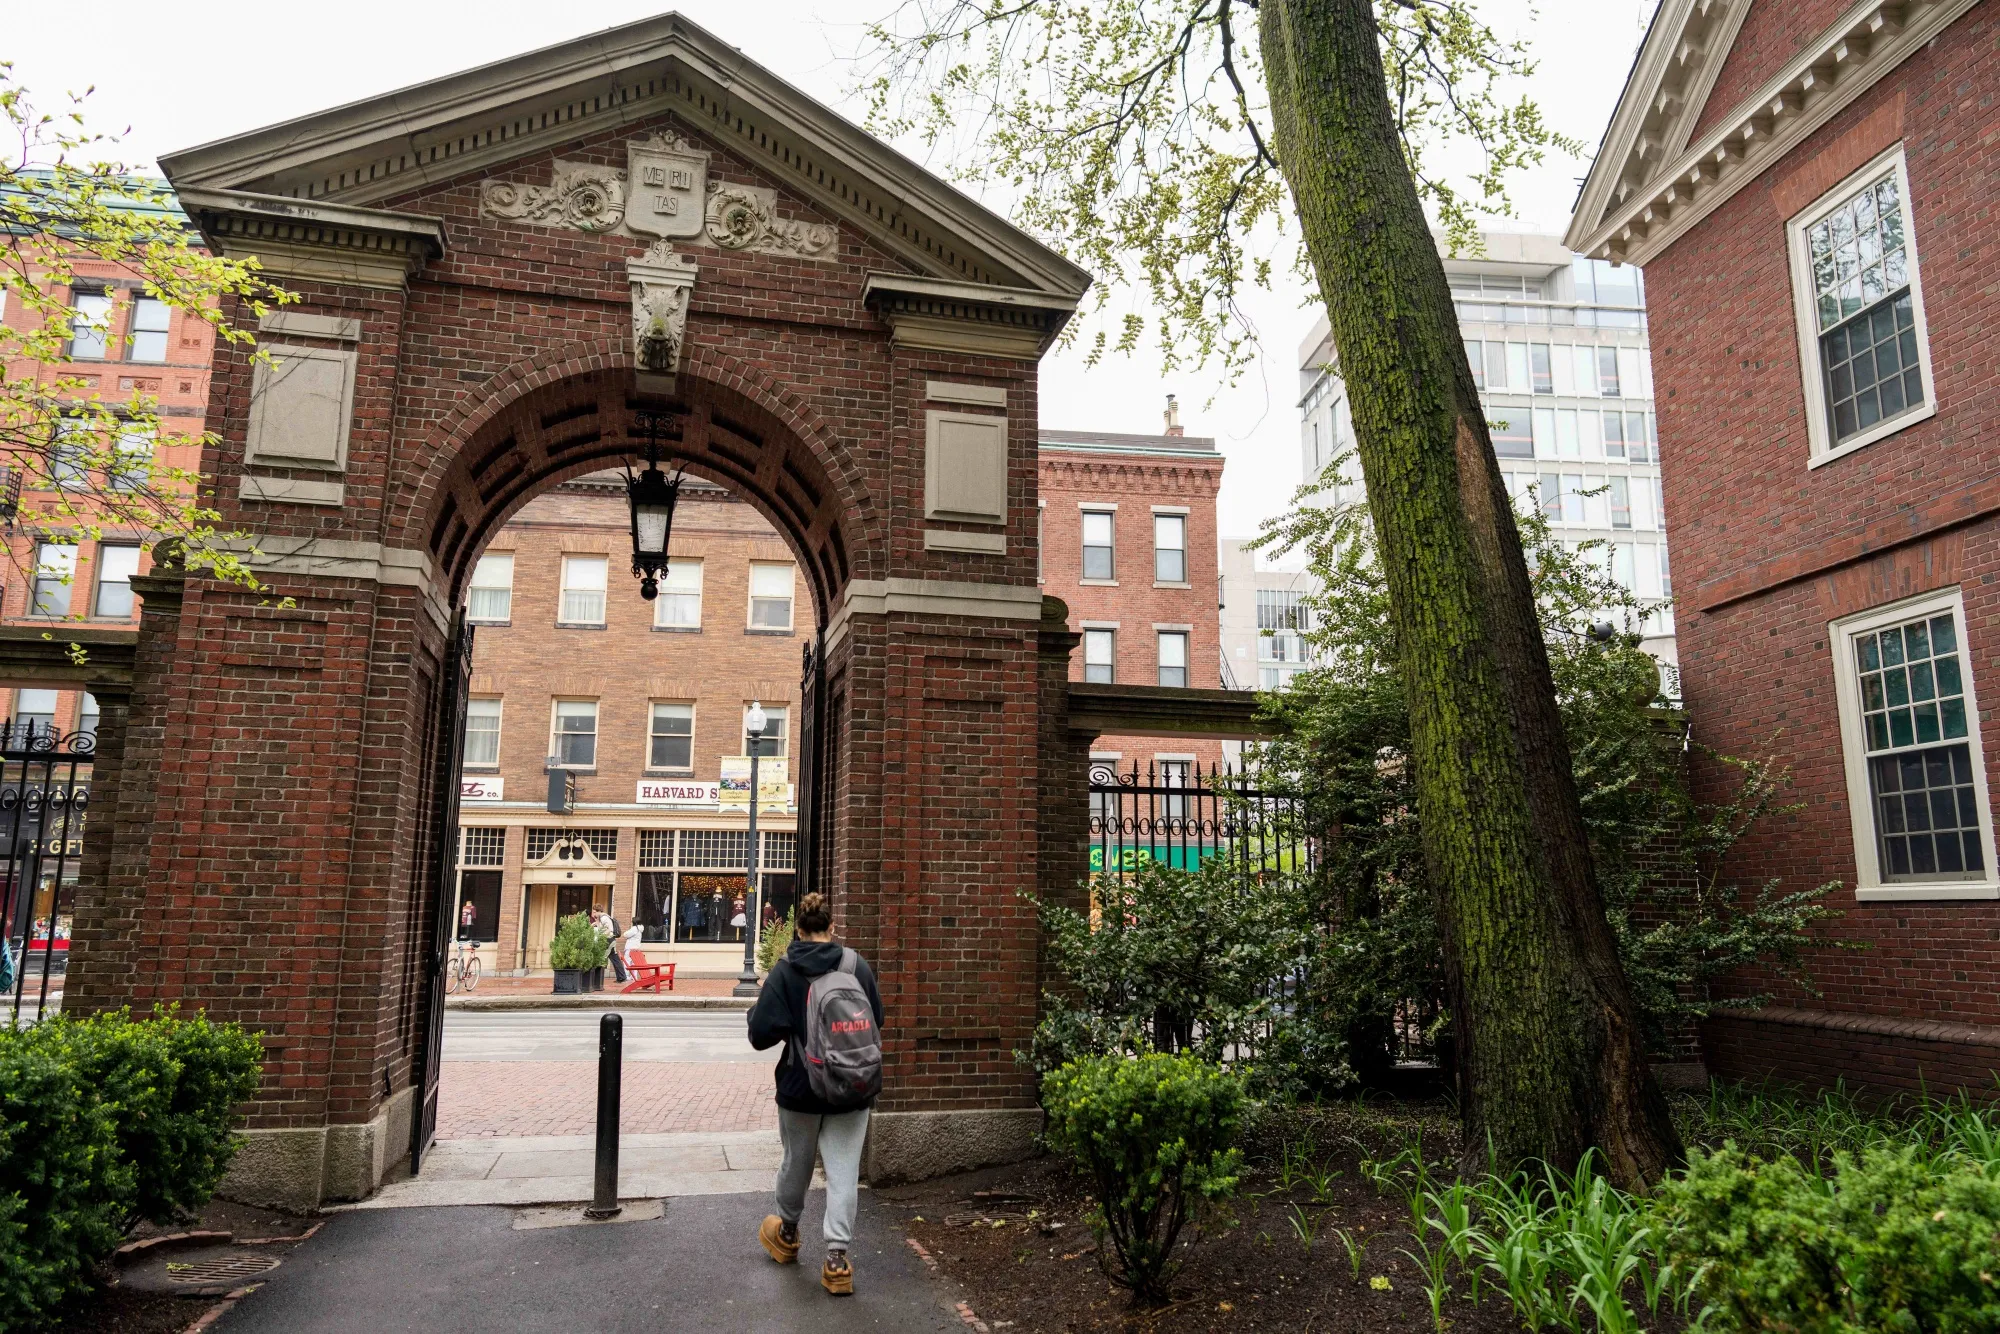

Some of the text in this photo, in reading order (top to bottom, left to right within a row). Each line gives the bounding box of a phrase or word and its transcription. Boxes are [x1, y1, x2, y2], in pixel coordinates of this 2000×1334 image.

[645, 166, 688, 186] VE RI
[655, 195, 676, 211] TAS
[642, 786, 704, 799] HARVARD
[831, 1019, 871, 1033] ARCADIA
